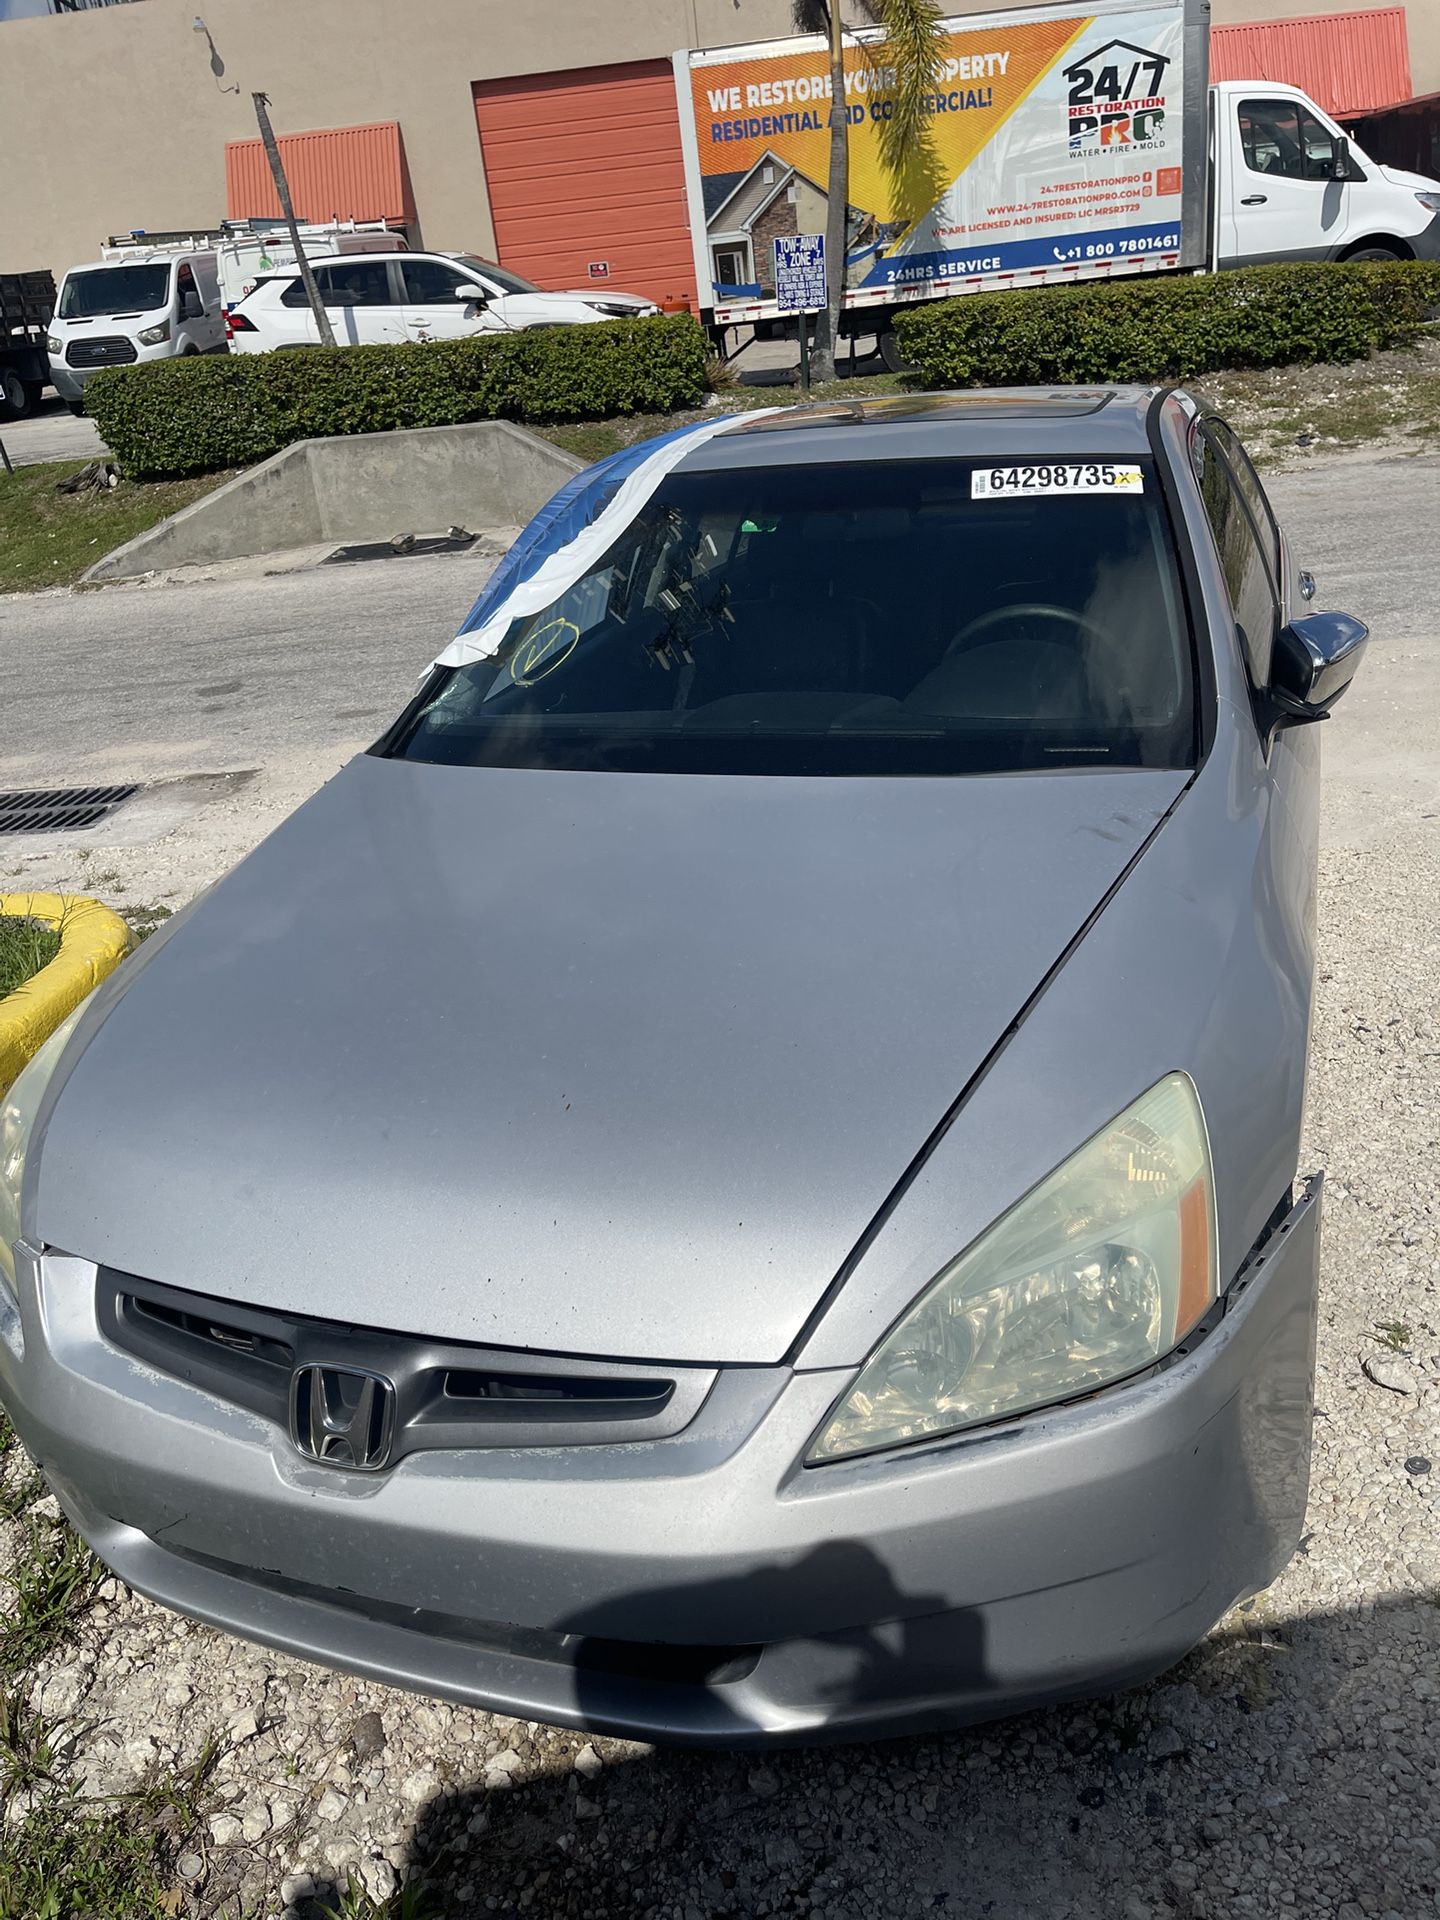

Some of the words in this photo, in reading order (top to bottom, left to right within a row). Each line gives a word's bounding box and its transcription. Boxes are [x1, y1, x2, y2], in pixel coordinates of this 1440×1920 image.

[706, 86, 742, 113] WE
[746, 74, 833, 108] RESTORE
[902, 51, 1010, 87] OPERTY
[1068, 61, 1165, 106] 24/7
[711, 110, 822, 144] RESIDENTIAL
[870, 87, 992, 122] COERCIAL!
[1068, 97, 1165, 117] RESTORATION
[1069, 108, 1165, 150] PRO
[1069, 148, 1100, 159] WATER
[1109, 144, 1130, 154] FIRE
[1139, 140, 1166, 150] MOLD
[948, 225, 966, 236] ARE
[968, 220, 1011, 232] LICENSED
[1013, 216, 1032, 227] AND
[1035, 212, 1076, 224] INSURED:
[1078, 208, 1092, 218] LIC
[816, 249, 821, 258] 7
[1086, 243, 1114, 257] 800
[1119, 234, 1178, 253] 7801461
[790, 251, 812, 267] ZONE
[887, 265, 934, 282] 24HRS
[938, 257, 1001, 276] SERVICE
[990, 465, 1117, 490] 64298735
